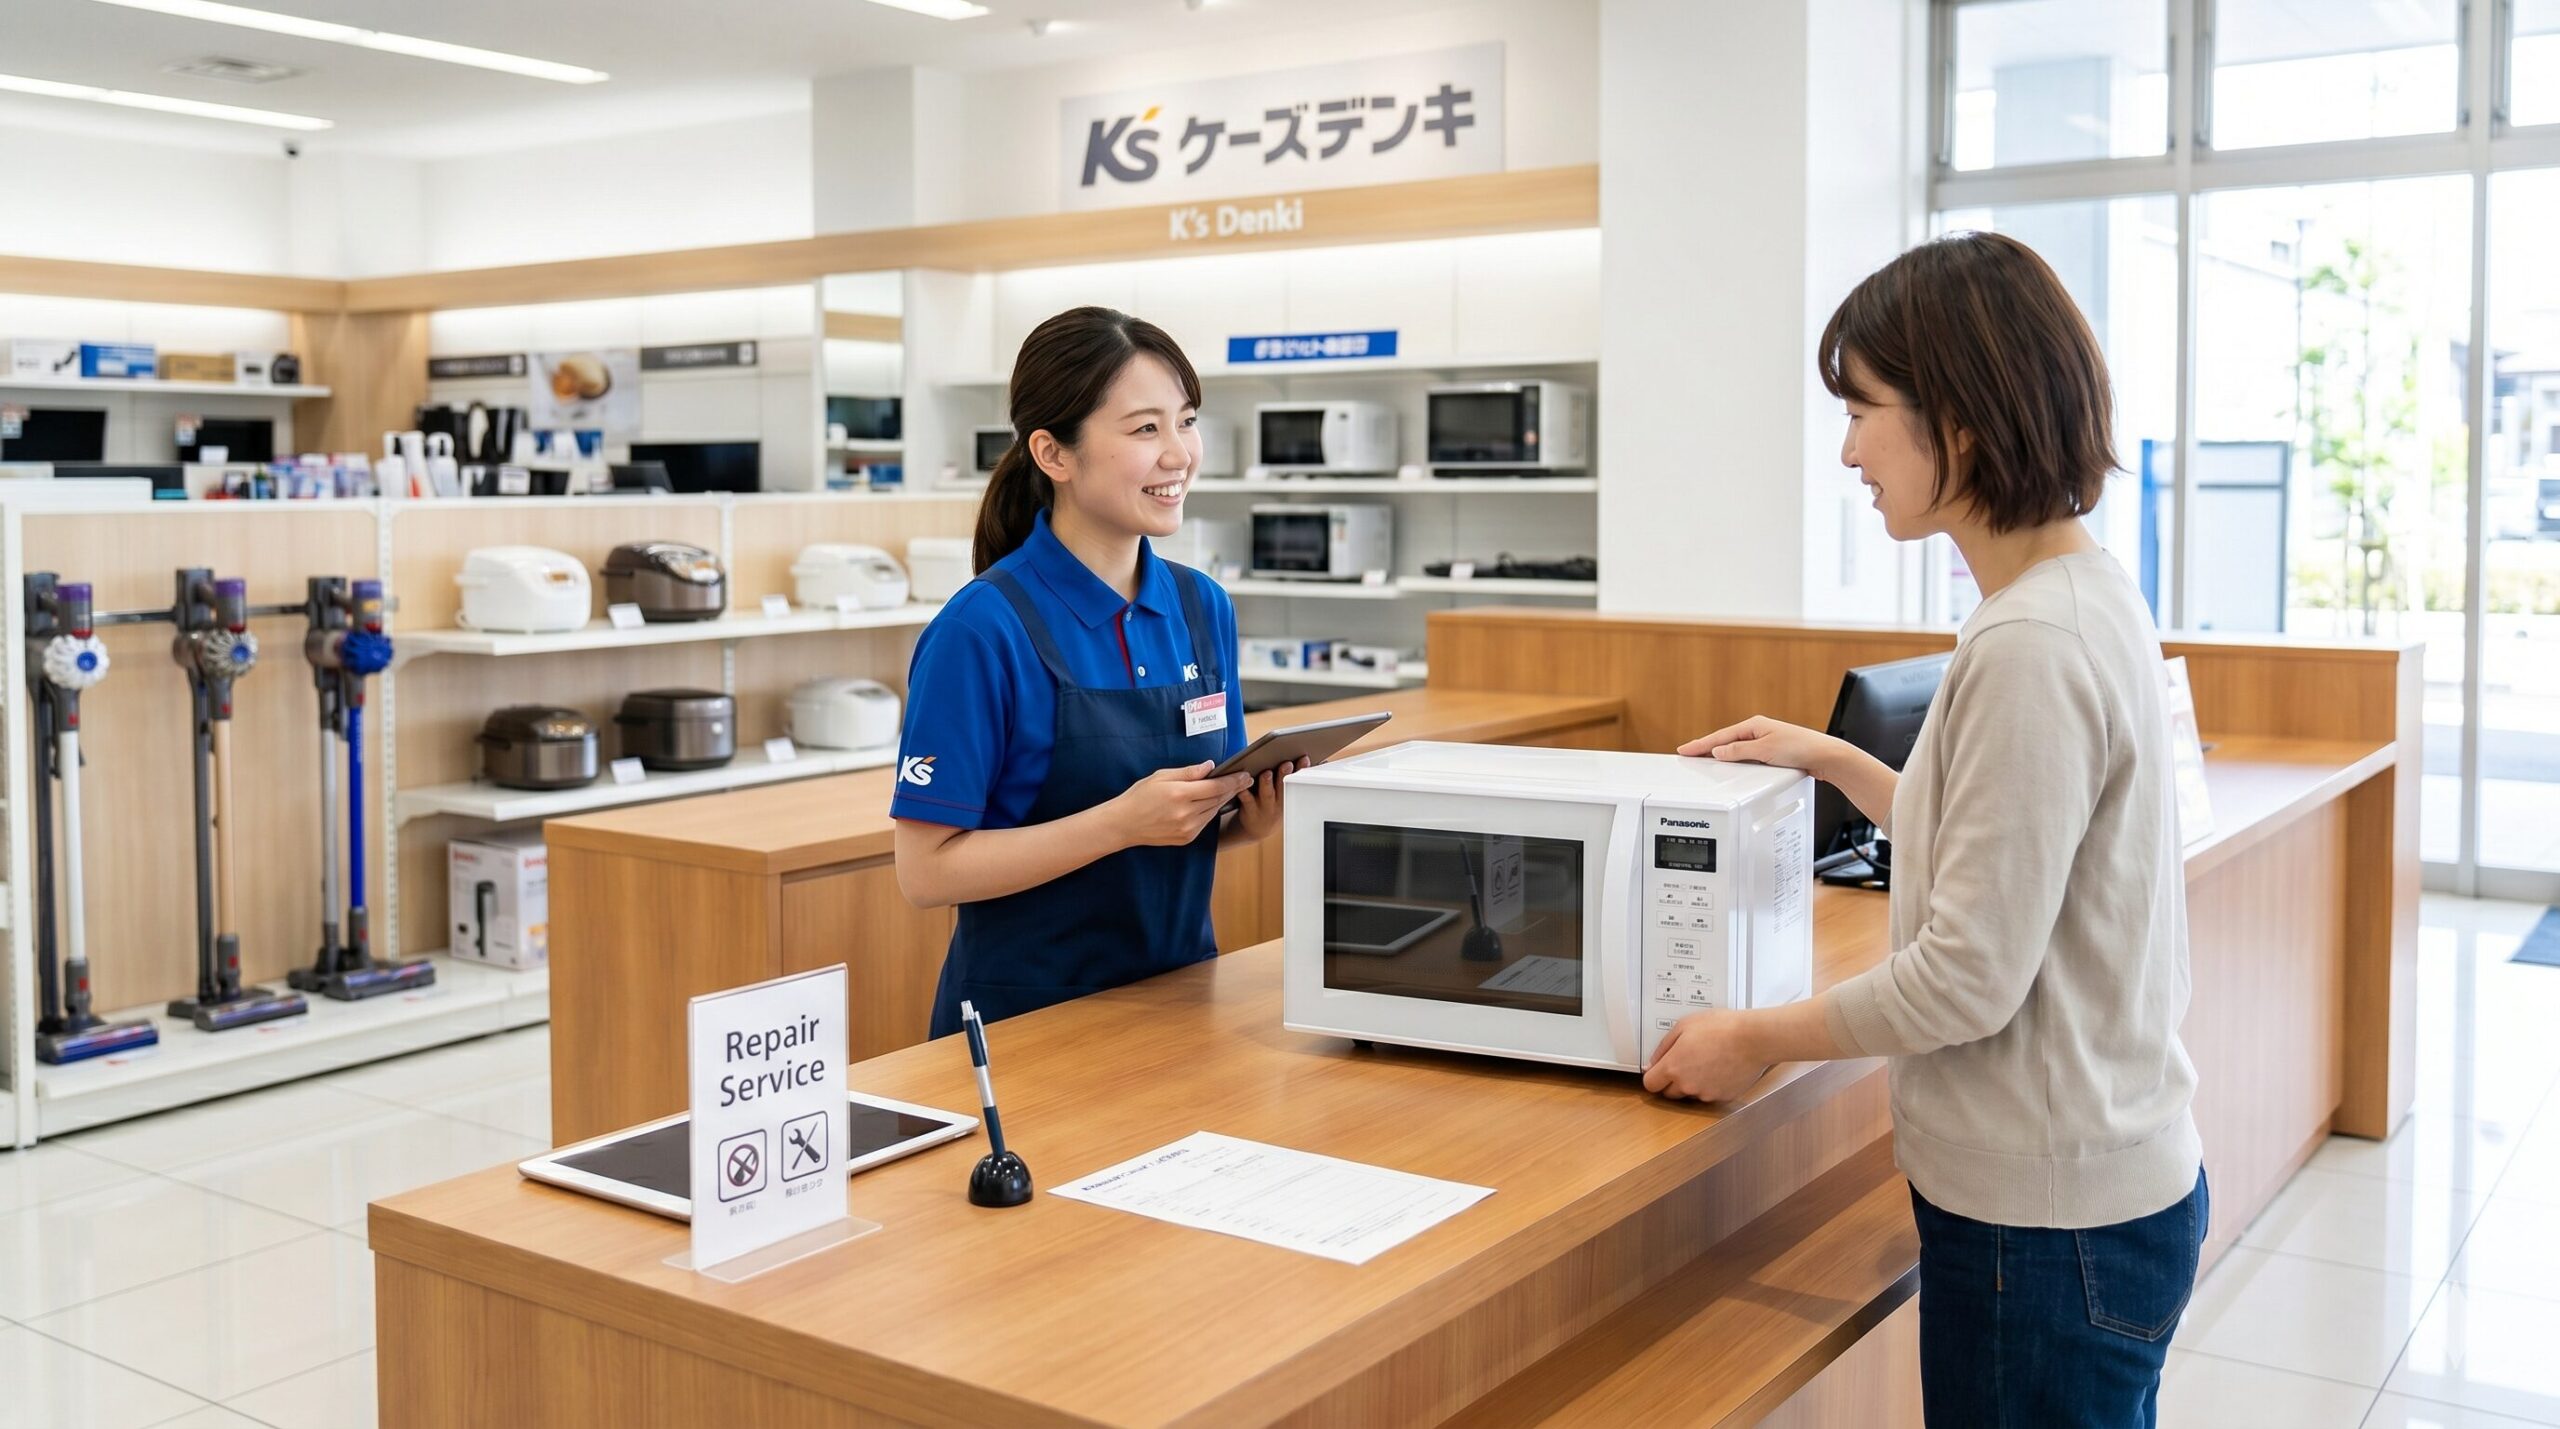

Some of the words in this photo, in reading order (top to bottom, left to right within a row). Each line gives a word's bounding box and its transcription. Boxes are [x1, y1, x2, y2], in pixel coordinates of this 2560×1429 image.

[1081, 105, 1163, 187] K's
[1180, 84, 1475, 175] ケーズデンキ
[1171, 208, 1208, 240] K's
[1216, 199, 1303, 236] Denki
[898, 755, 937, 786] K's
[1660, 817, 1710, 829] Panasonic
[726, 1014, 820, 1063] Repair
[720, 1059, 825, 1107] Service
